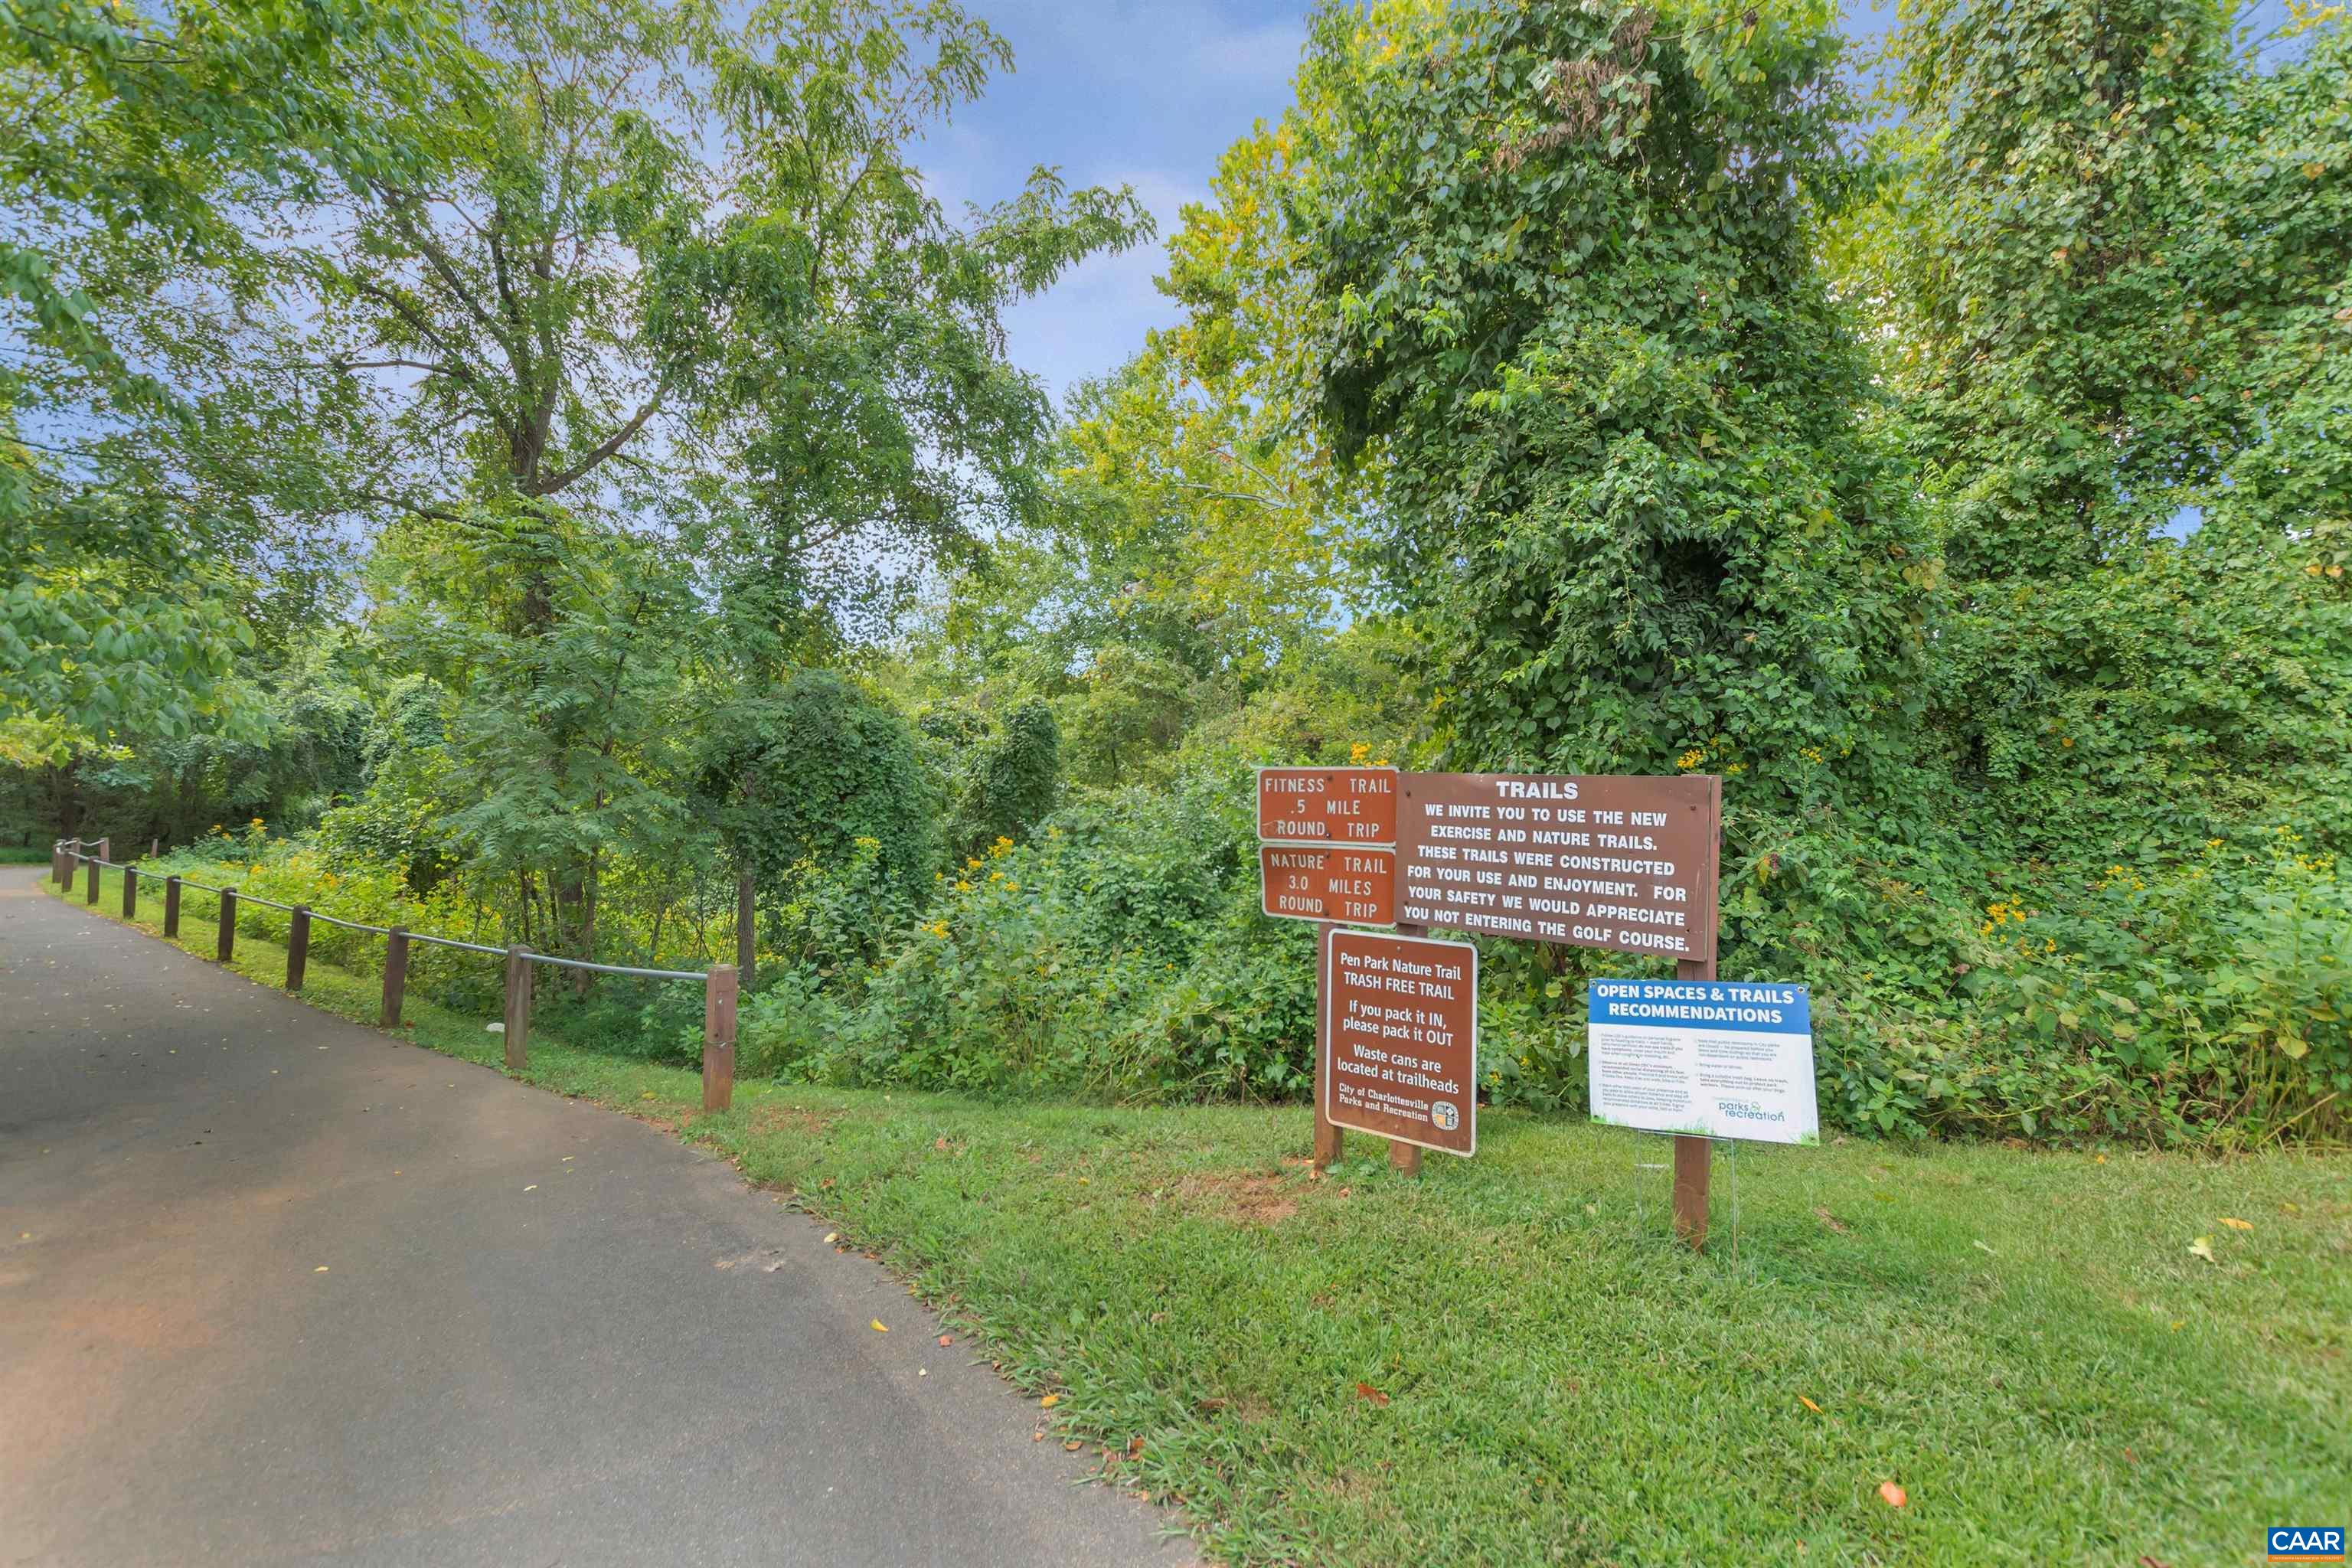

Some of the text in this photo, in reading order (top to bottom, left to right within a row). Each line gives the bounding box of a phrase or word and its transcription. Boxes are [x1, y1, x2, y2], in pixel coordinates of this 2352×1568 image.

[1265, 778, 1391, 793] FITNESS TRAIL
[1496, 781, 1579, 800] TRAILS
[1291, 799, 1361, 815] .5 MILE
[1425, 804, 1667, 827] WE INVITE YOU TO USE THE NEW
[1277, 821, 1380, 838] ROUND TRIP
[1431, 825, 1658, 851] EXERCISE AND NATURE TRAILS.
[1271, 854, 1387, 874] NATURE TRAIL
[1417, 845, 1675, 876] THESE TRAILS WERE CONSTRUCTED
[1289, 875, 1372, 896] 3.0 MILES
[1407, 865, 1687, 902] FOR YOUR USE AND ENJOYMENT. FOR
[1279, 895, 1377, 919] ROUND TRIP
[1409, 886, 1685, 926] YOUR SAFETY WE WOULD APPRECIATE
[1404, 906, 1690, 952] YOU NOT ENTERING THE GOLF COURSE.
[1341, 952, 1462, 981] Pen Park Nature Trail
[1344, 972, 1455, 1000] TRASH FREE TRAIL
[1597, 985, 1795, 1004] OPEN SPACES & TRAILS
[1349, 999, 1447, 1030] If you pack it IN,
[1609, 1003, 1783, 1024] RECOMMENDATIONS
[1343, 1016, 1454, 1047] please pack it OUT
[1354, 1044, 1442, 1073] Waste cans are
[1338, 1057, 1459, 1095] located at trailheads
[1339, 1083, 1429, 1111] City of Charlottesville
[1339, 1093, 1363, 1107] Parks
[1365, 1102, 1381, 1111] and
[1383, 1103, 1429, 1122] Recreation
[1719, 1102, 1749, 1112] parks
[1725, 1110, 1785, 1121] recreation
